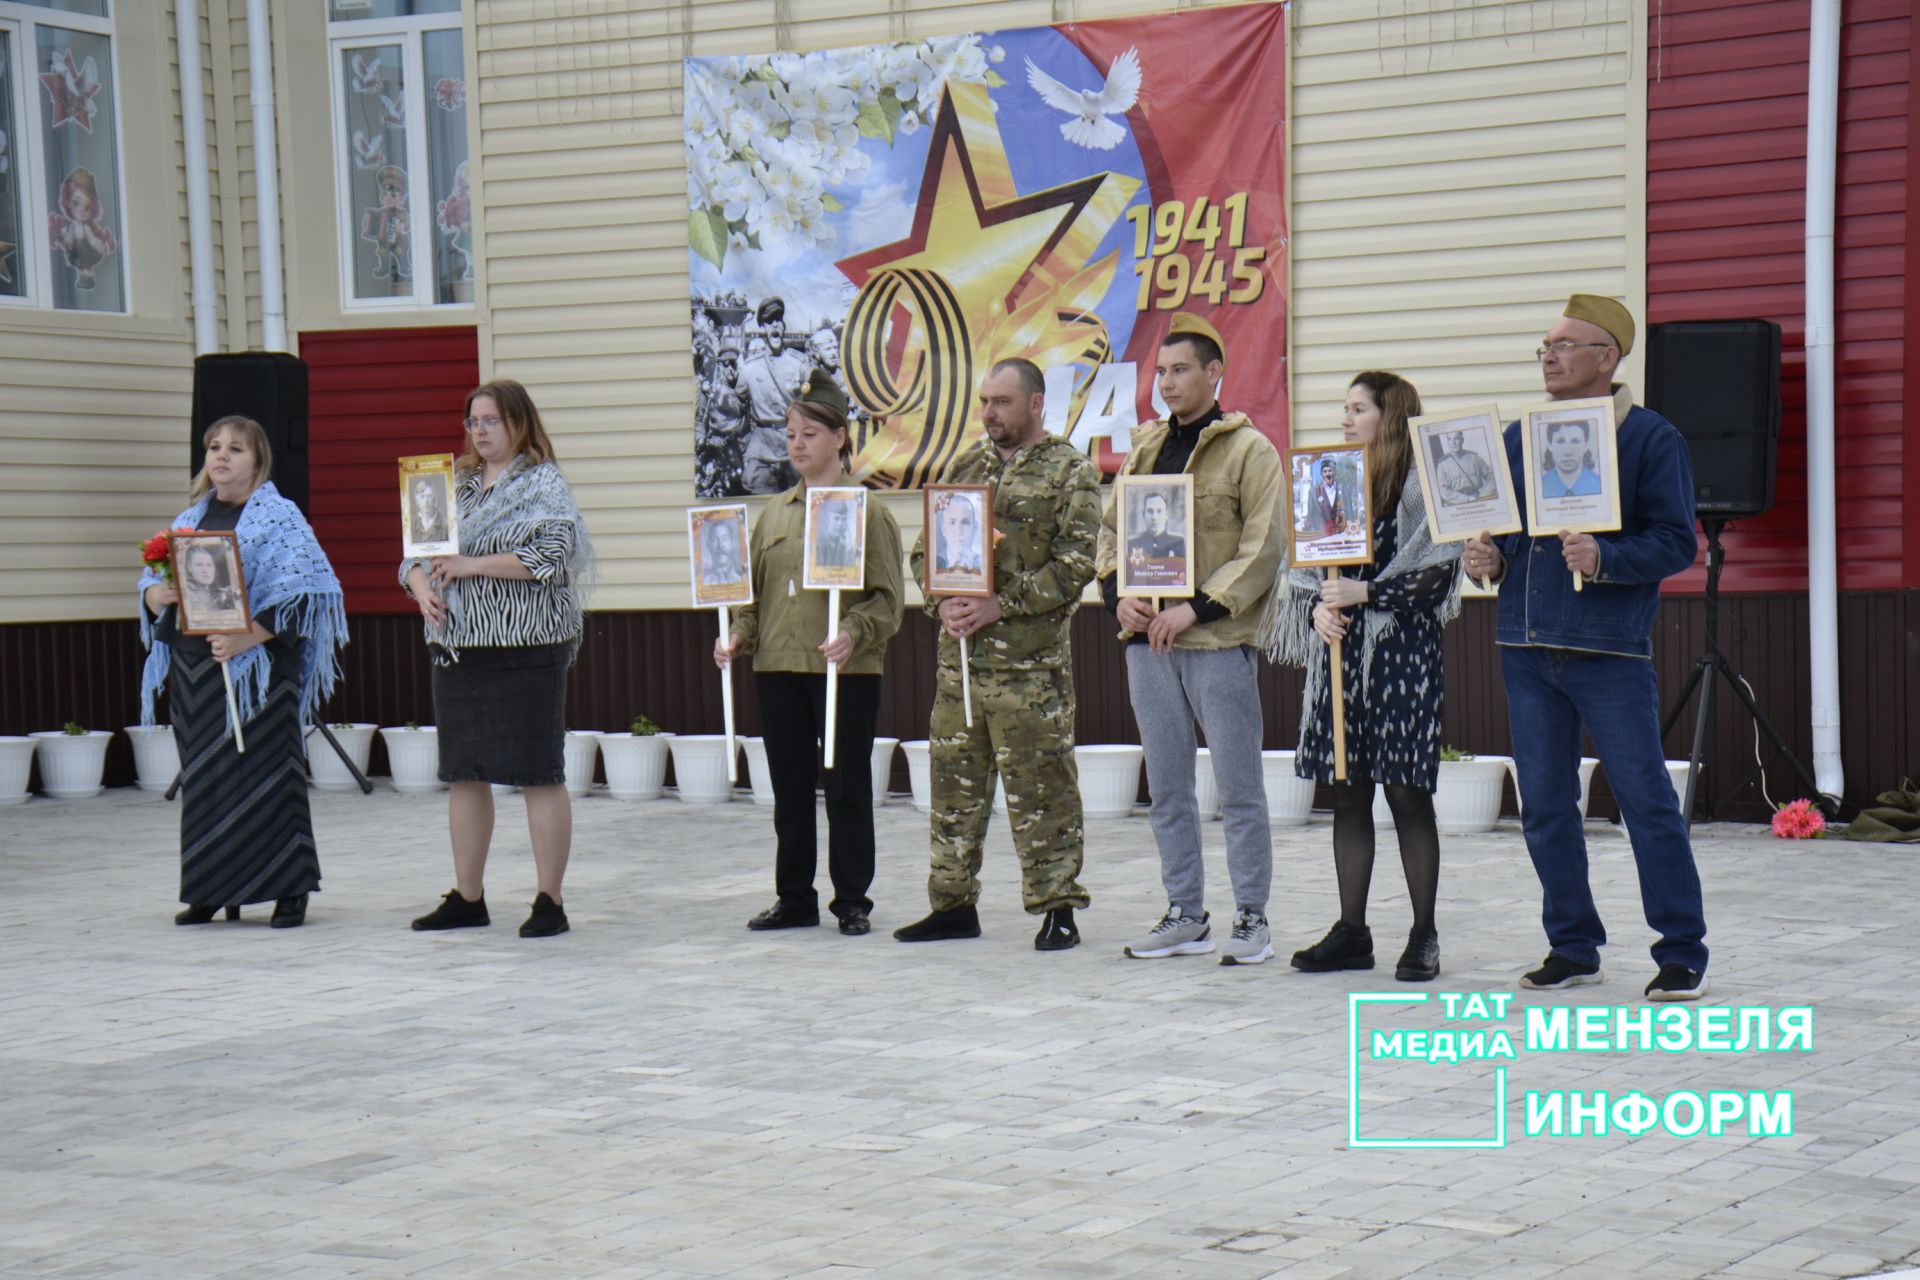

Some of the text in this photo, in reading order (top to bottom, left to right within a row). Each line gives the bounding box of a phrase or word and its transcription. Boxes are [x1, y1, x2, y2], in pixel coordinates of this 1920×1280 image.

[1126, 191, 1249, 259] 1941
[1133, 246, 1267, 312] 1945
[840, 267, 973, 490] 9
